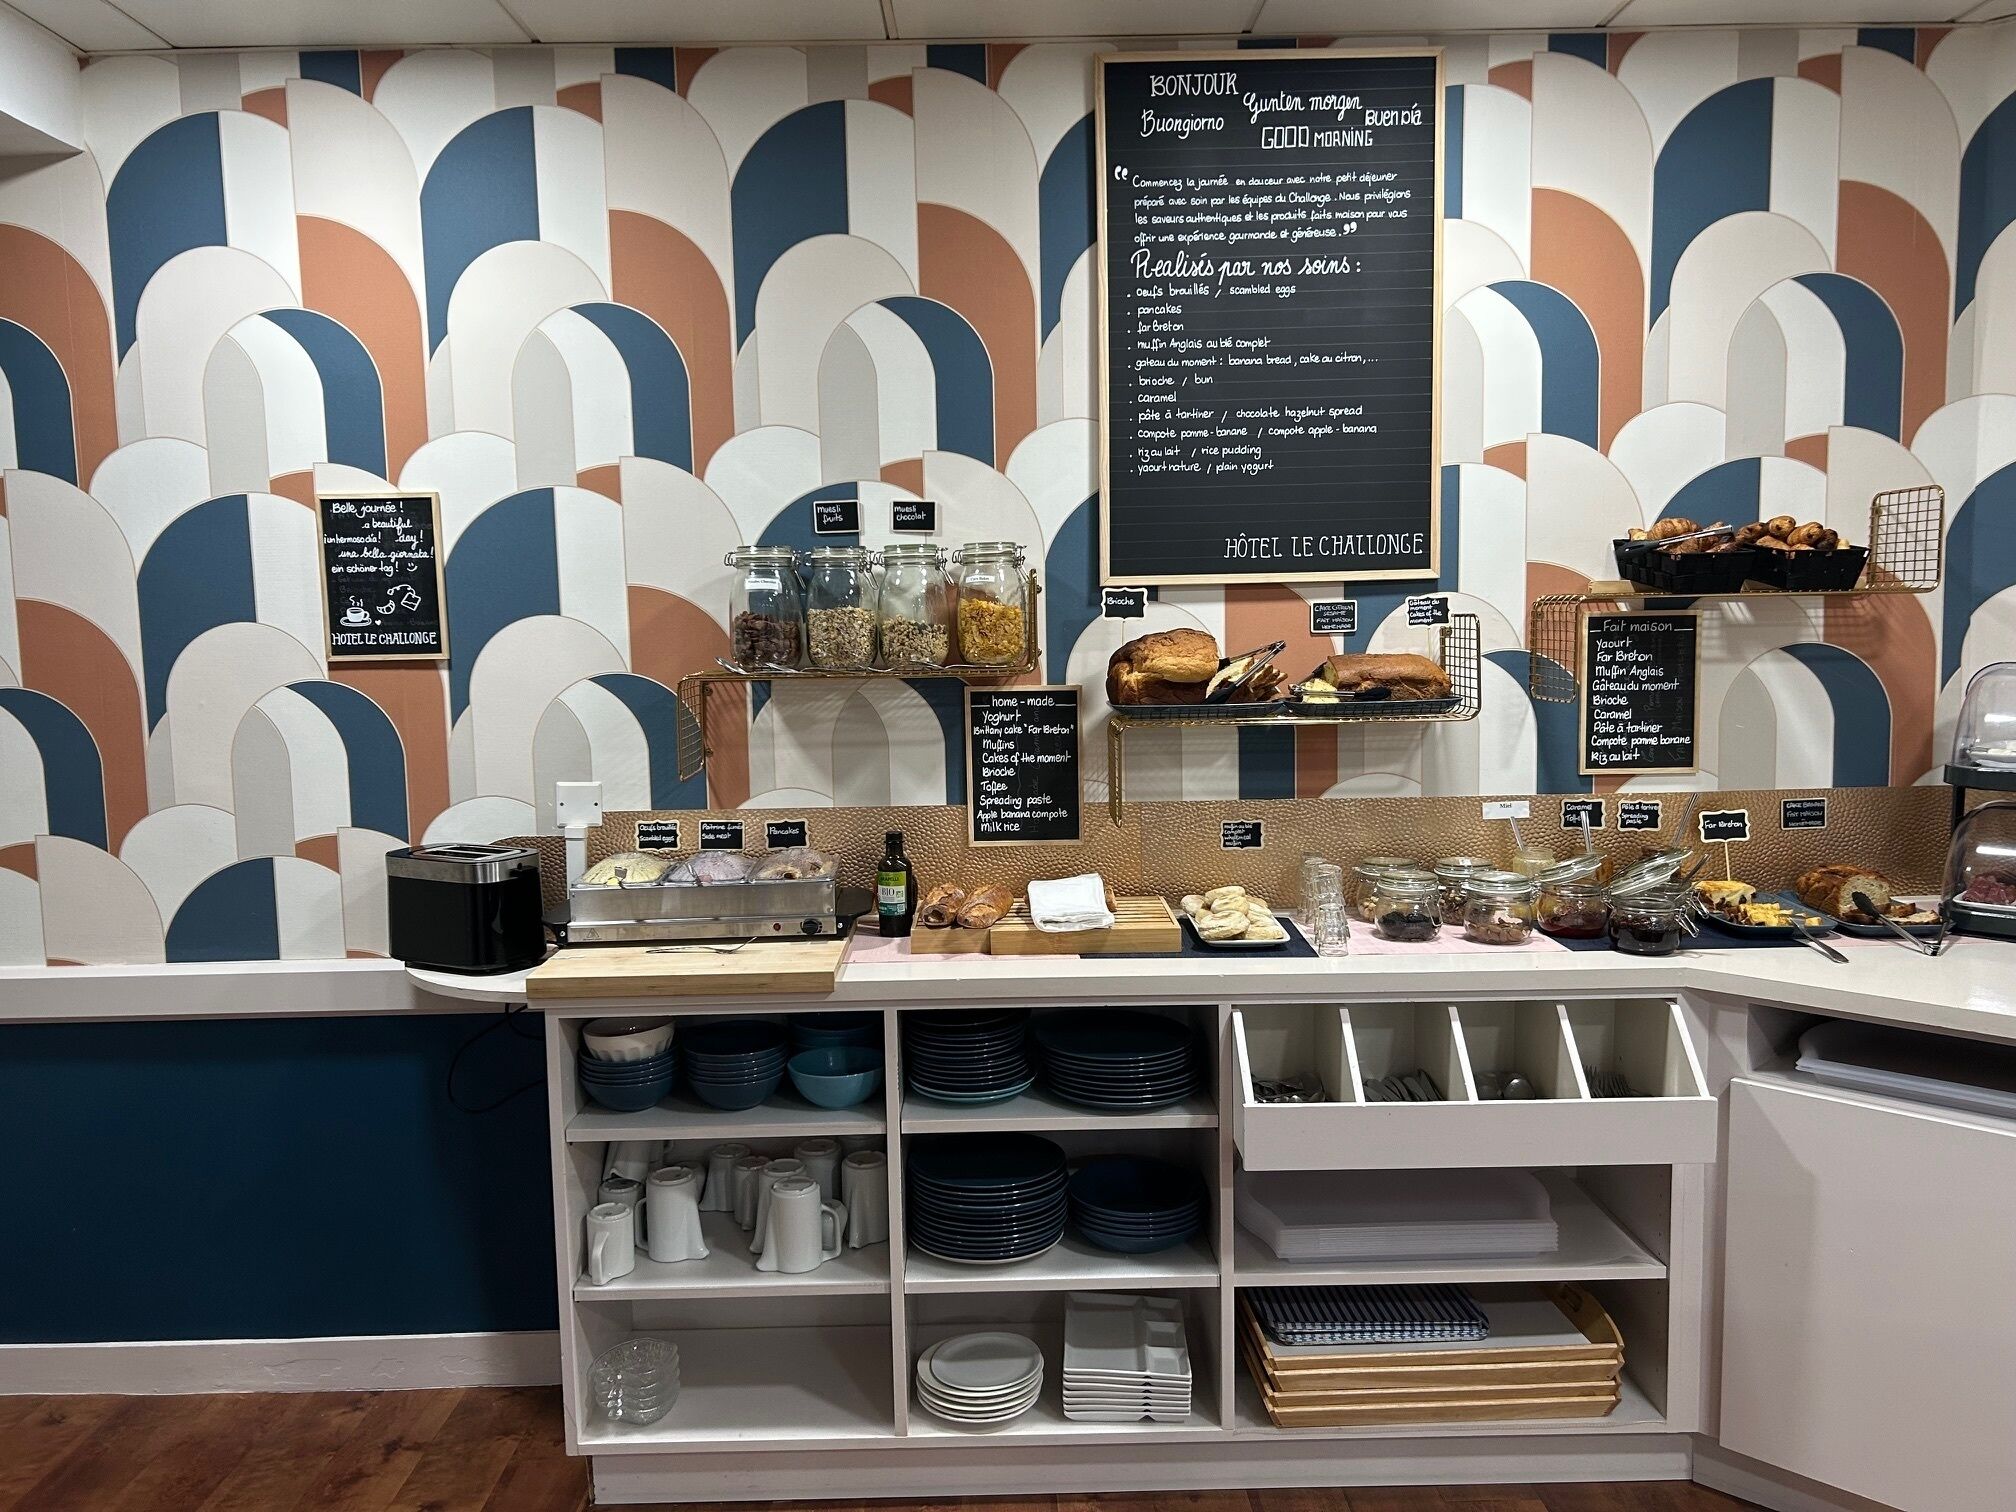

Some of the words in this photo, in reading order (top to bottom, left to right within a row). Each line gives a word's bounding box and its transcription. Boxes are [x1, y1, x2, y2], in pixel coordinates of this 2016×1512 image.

[1150, 73, 1239, 96] BONJOUR
[1243, 91, 1305, 125] Gunten
[1309, 94, 1362, 121] morgen
[1141, 109, 1224, 139] Buongiorno
[1261, 126, 1309, 149] GOOD
[1248, 177, 1283, 186] douceur
[1310, 173, 1332, 183] notre
[1336, 172, 1357, 186] petit
[1360, 172, 1398, 186] déjeuner
[1134, 195, 1165, 209] préparé
[1191, 197, 1207, 205] soin
[1242, 194, 1272, 207] équipes
[1339, 192, 1361, 201] Nous
[1364, 188, 1411, 204] privilégions
[1135, 213, 1148, 225] les
[1152, 214, 1185, 224] saveurs
[1186, 212, 1242, 226] authentiques
[1271, 208, 1307, 224] produits
[1310, 208, 1332, 222] faits
[1335, 209, 1364, 219] maison
[1366, 211, 1386, 222] pour
[1388, 209, 1408, 219] vous
[1134, 232, 1155, 247] offrir
[1177, 230, 1227, 245] expérience
[1229, 230, 1277, 245] gourmande
[1218, 259, 1256, 285] par
[1261, 259, 1292, 275] nos
[1169, 282, 1210, 296] brouillés
[1229, 284, 1270, 295] scambled
[1275, 285, 1297, 299] eggs
[1137, 302, 1182, 319] pancakes
[1137, 321, 1151, 335] far
[1153, 320, 1184, 332] Breton
[1137, 338, 1167, 352] muffin
[1169, 338, 1203, 353] Anglais
[1235, 336, 1271, 352] complet
[1181, 356, 1217, 367] moment
[1228, 354, 1263, 366] banana
[1299, 353, 1320, 364] cake
[1138, 375, 1175, 386] brioche
[1194, 373, 1214, 384] bun
[1137, 391, 1177, 403] caramel
[1138, 408, 1161, 424] pâte
[1175, 408, 1215, 419] tartiner
[1236, 406, 1280, 418] chocolate
[1285, 406, 1326, 422] hazelnut
[1328, 405, 1363, 420] spread
[1137, 427, 1177, 442] compote
[1268, 425, 1305, 439] compote
[1138, 447, 1150, 462] riz
[1151, 449, 1162, 457] au
[1164, 445, 1181, 456] lait
[1201, 446, 1220, 455] rice
[1222, 445, 1262, 460] pudding
[1137, 460, 1168, 476] yaourt
[1168, 460, 1201, 472] nature
[1216, 460, 1238, 475] plain
[1241, 459, 1274, 476] yogurt
[332, 502, 357, 514] Belle
[823, 513, 844, 525] fruits
[896, 511, 927, 521] chocolat
[372, 517, 413, 535] beautiful
[360, 546, 387, 558] bella
[1223, 533, 1283, 559] HÔTEL
[1291, 536, 1314, 557] LE
[1318, 532, 1424, 556] CHALLONGE
[331, 565, 344, 573] ein
[346, 564, 378, 573] schöner
[1107, 597, 1135, 606] Brioche
[1603, 619, 1625, 632] Fait
[1630, 620, 1672, 632] maison
[365, 632, 377, 645] LE
[378, 632, 438, 645] CHALLONGE
[1596, 651, 1613, 662] Far
[1616, 650, 1653, 662] Breton
[1595, 665, 1627, 680] Muffin
[1629, 665, 1664, 681] Anglais
[1592, 679, 1627, 691] Gâteau
[1627, 680, 1639, 691] du
[1642, 678, 1680, 691] moment
[1592, 695, 1628, 706] Brioche
[982, 709, 1022, 725] Yoghurt
[1594, 709, 1632, 720] Caramel
[973, 726, 1003, 737] Brittany
[1004, 724, 1023, 734] cake
[1594, 722, 1615, 734] Pâte
[1616, 723, 1624, 733] à
[1626, 721, 1663, 733] tartiner
[982, 739, 1015, 752] Muffins
[1591, 735, 1628, 749] Compote
[1631, 737, 1659, 748] pomme
[1660, 734, 1691, 745] banane
[982, 753, 1009, 763] Cakes
[1010, 752, 1019, 766] of
[1021, 752, 1036, 763] the
[1037, 750, 1071, 763] moment
[1591, 751, 1608, 765] Riz
[1609, 752, 1621, 762] au
[1622, 748, 1640, 761] lait
[982, 766, 1016, 777] Brioche
[981, 780, 1008, 795] Toffee
[979, 795, 1022, 810] Spreading
[1027, 793, 1052, 808] paste
[1566, 803, 1593, 811] Caramel
[977, 810, 998, 823] Apple
[1001, 808, 1030, 819] banana
[1032, 808, 1068, 821] compote
[1622, 812, 1649, 821] Spreading
[769, 826, 800, 835] Pancakes
[1004, 822, 1020, 831] rice
[1704, 820, 1717, 829] Far
[1718, 820, 1743, 828] Breton
[881, 887, 895, 896] BIO
